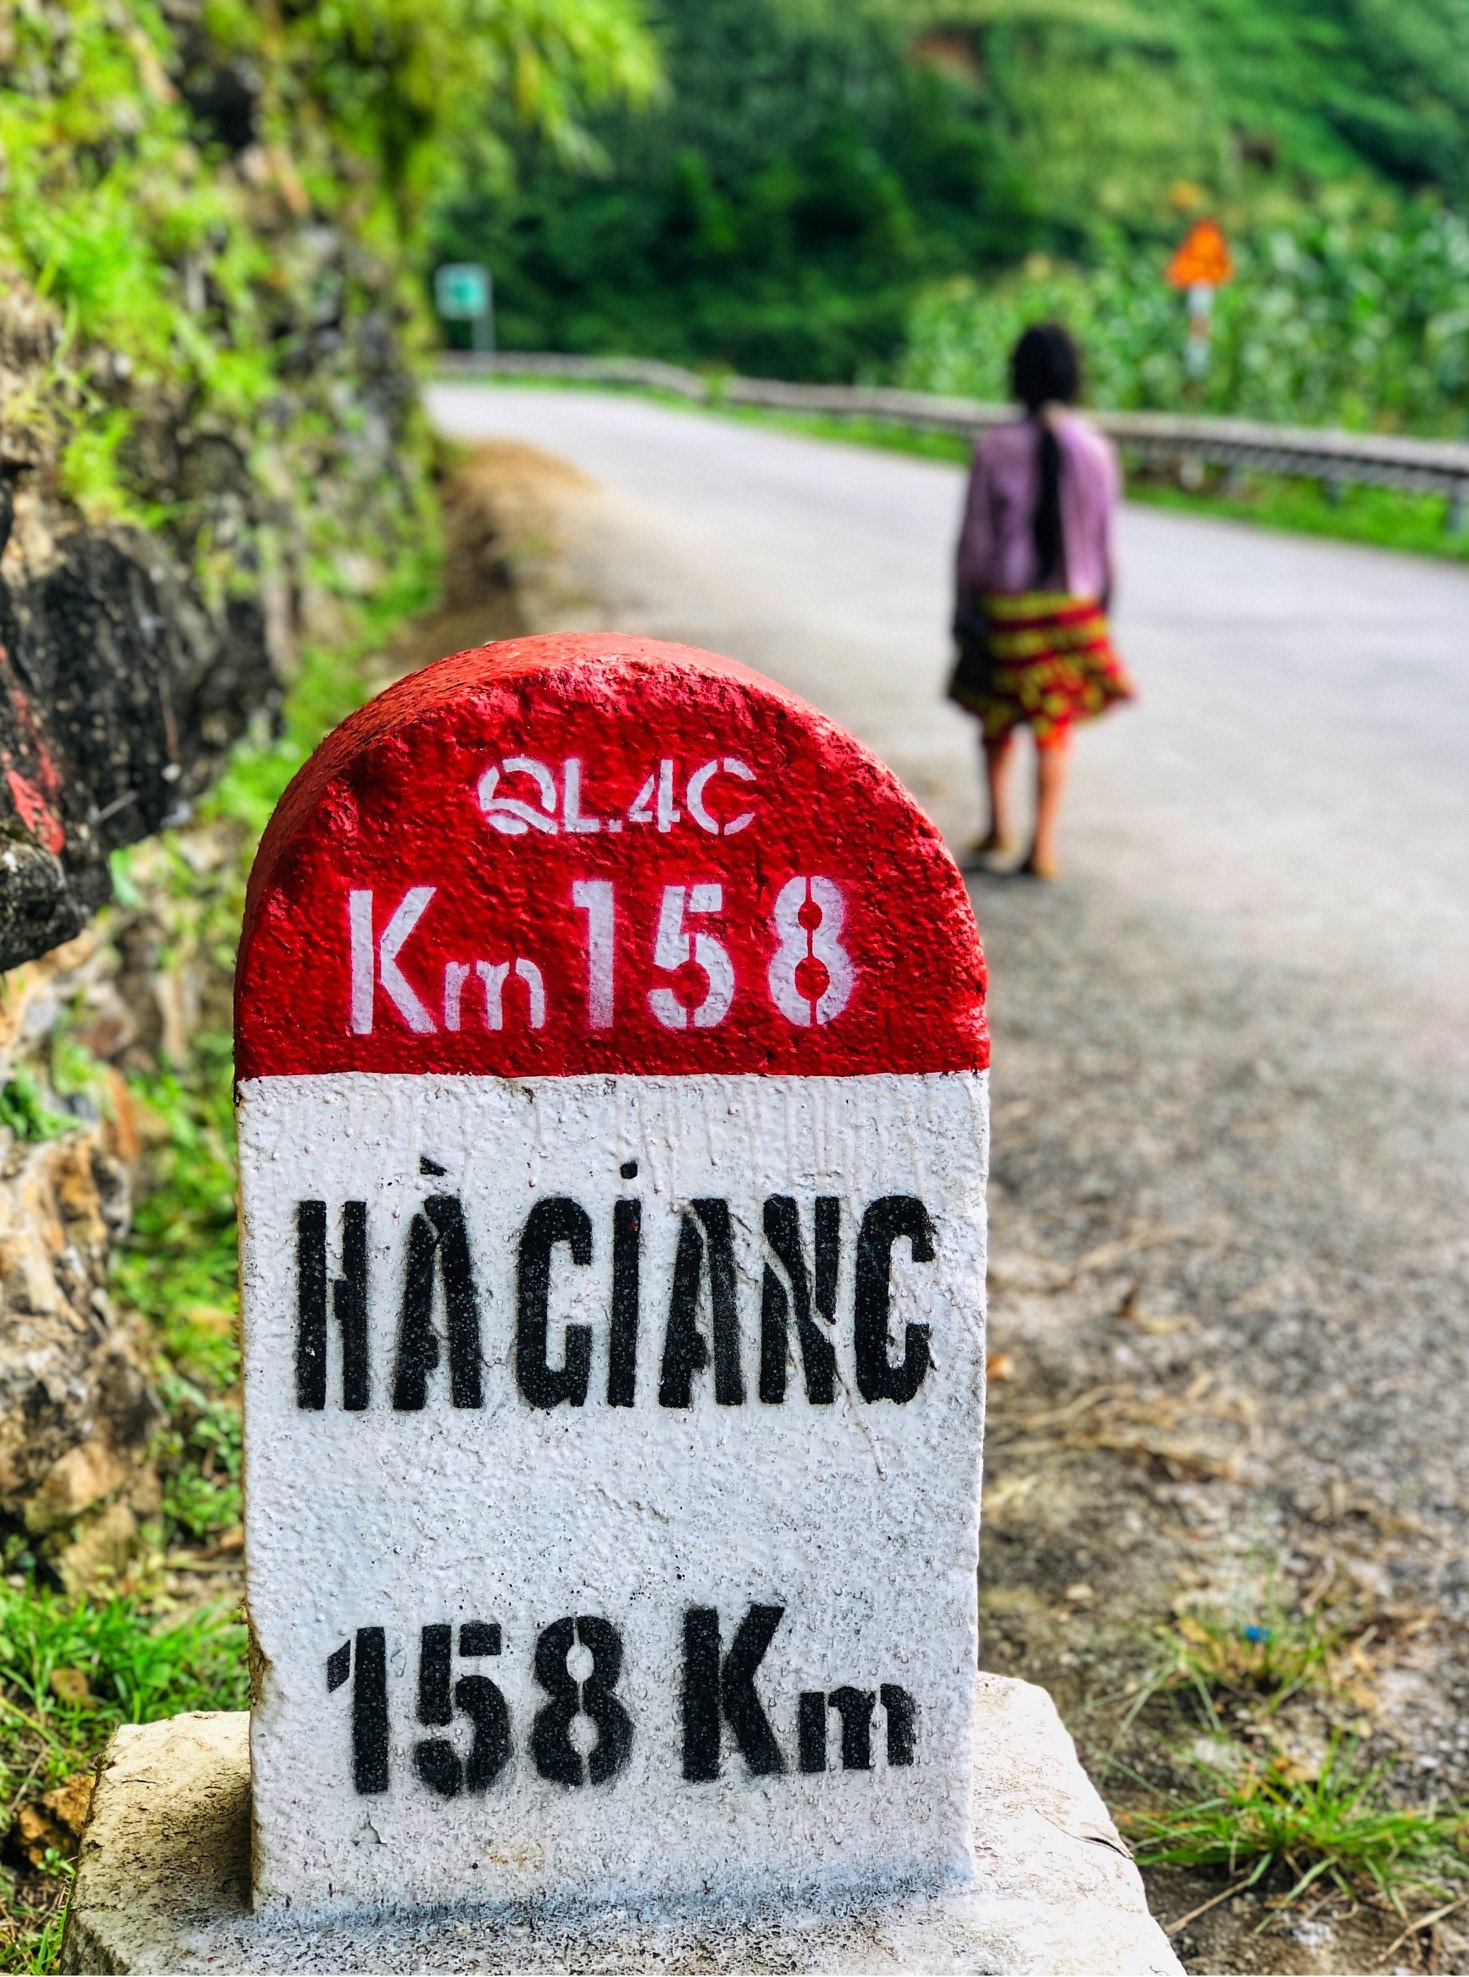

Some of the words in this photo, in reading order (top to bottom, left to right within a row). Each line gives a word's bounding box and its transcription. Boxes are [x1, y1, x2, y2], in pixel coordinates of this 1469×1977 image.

[477, 755, 757, 837] QL.4C
[348, 885, 546, 1036] Km
[570, 876, 858, 1031] 158
[327, 1615, 637, 1802] 158
[676, 1602, 917, 1784] Km
